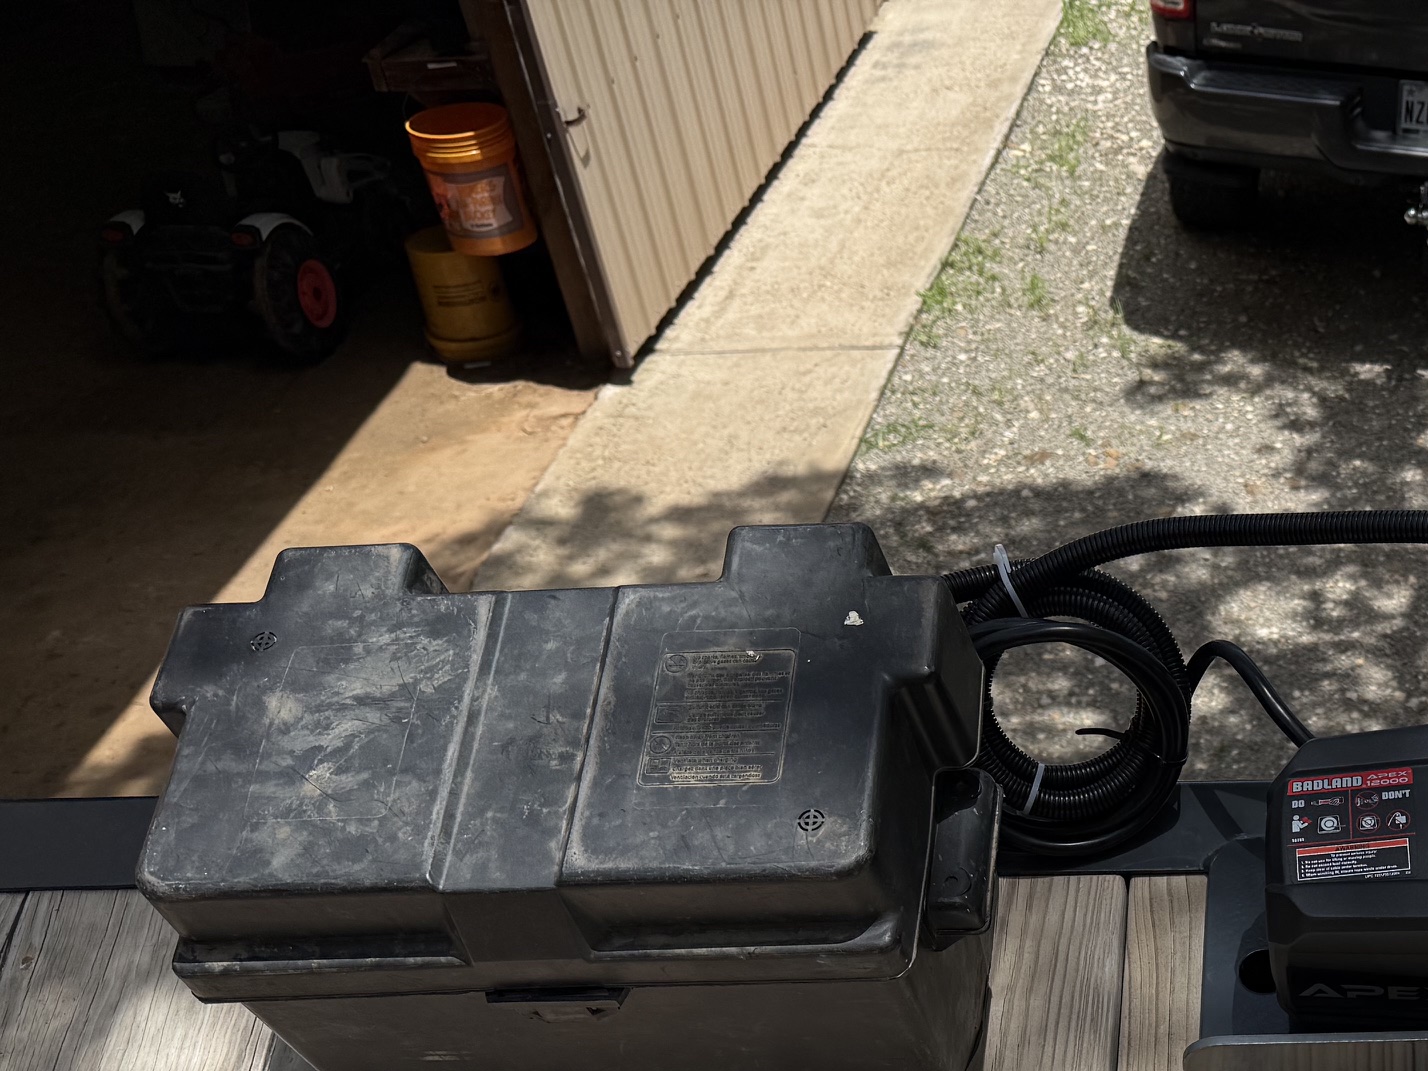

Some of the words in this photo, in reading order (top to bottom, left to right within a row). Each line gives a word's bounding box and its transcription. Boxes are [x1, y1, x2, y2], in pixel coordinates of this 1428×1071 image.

[1367, 770, 1408, 780] APEX
[1292, 776, 1362, 793] BADLAND
[1366, 777, 1409, 787] 12000
[1382, 789, 1411, 800] DON'T
[1292, 800, 1305, 809] DO
